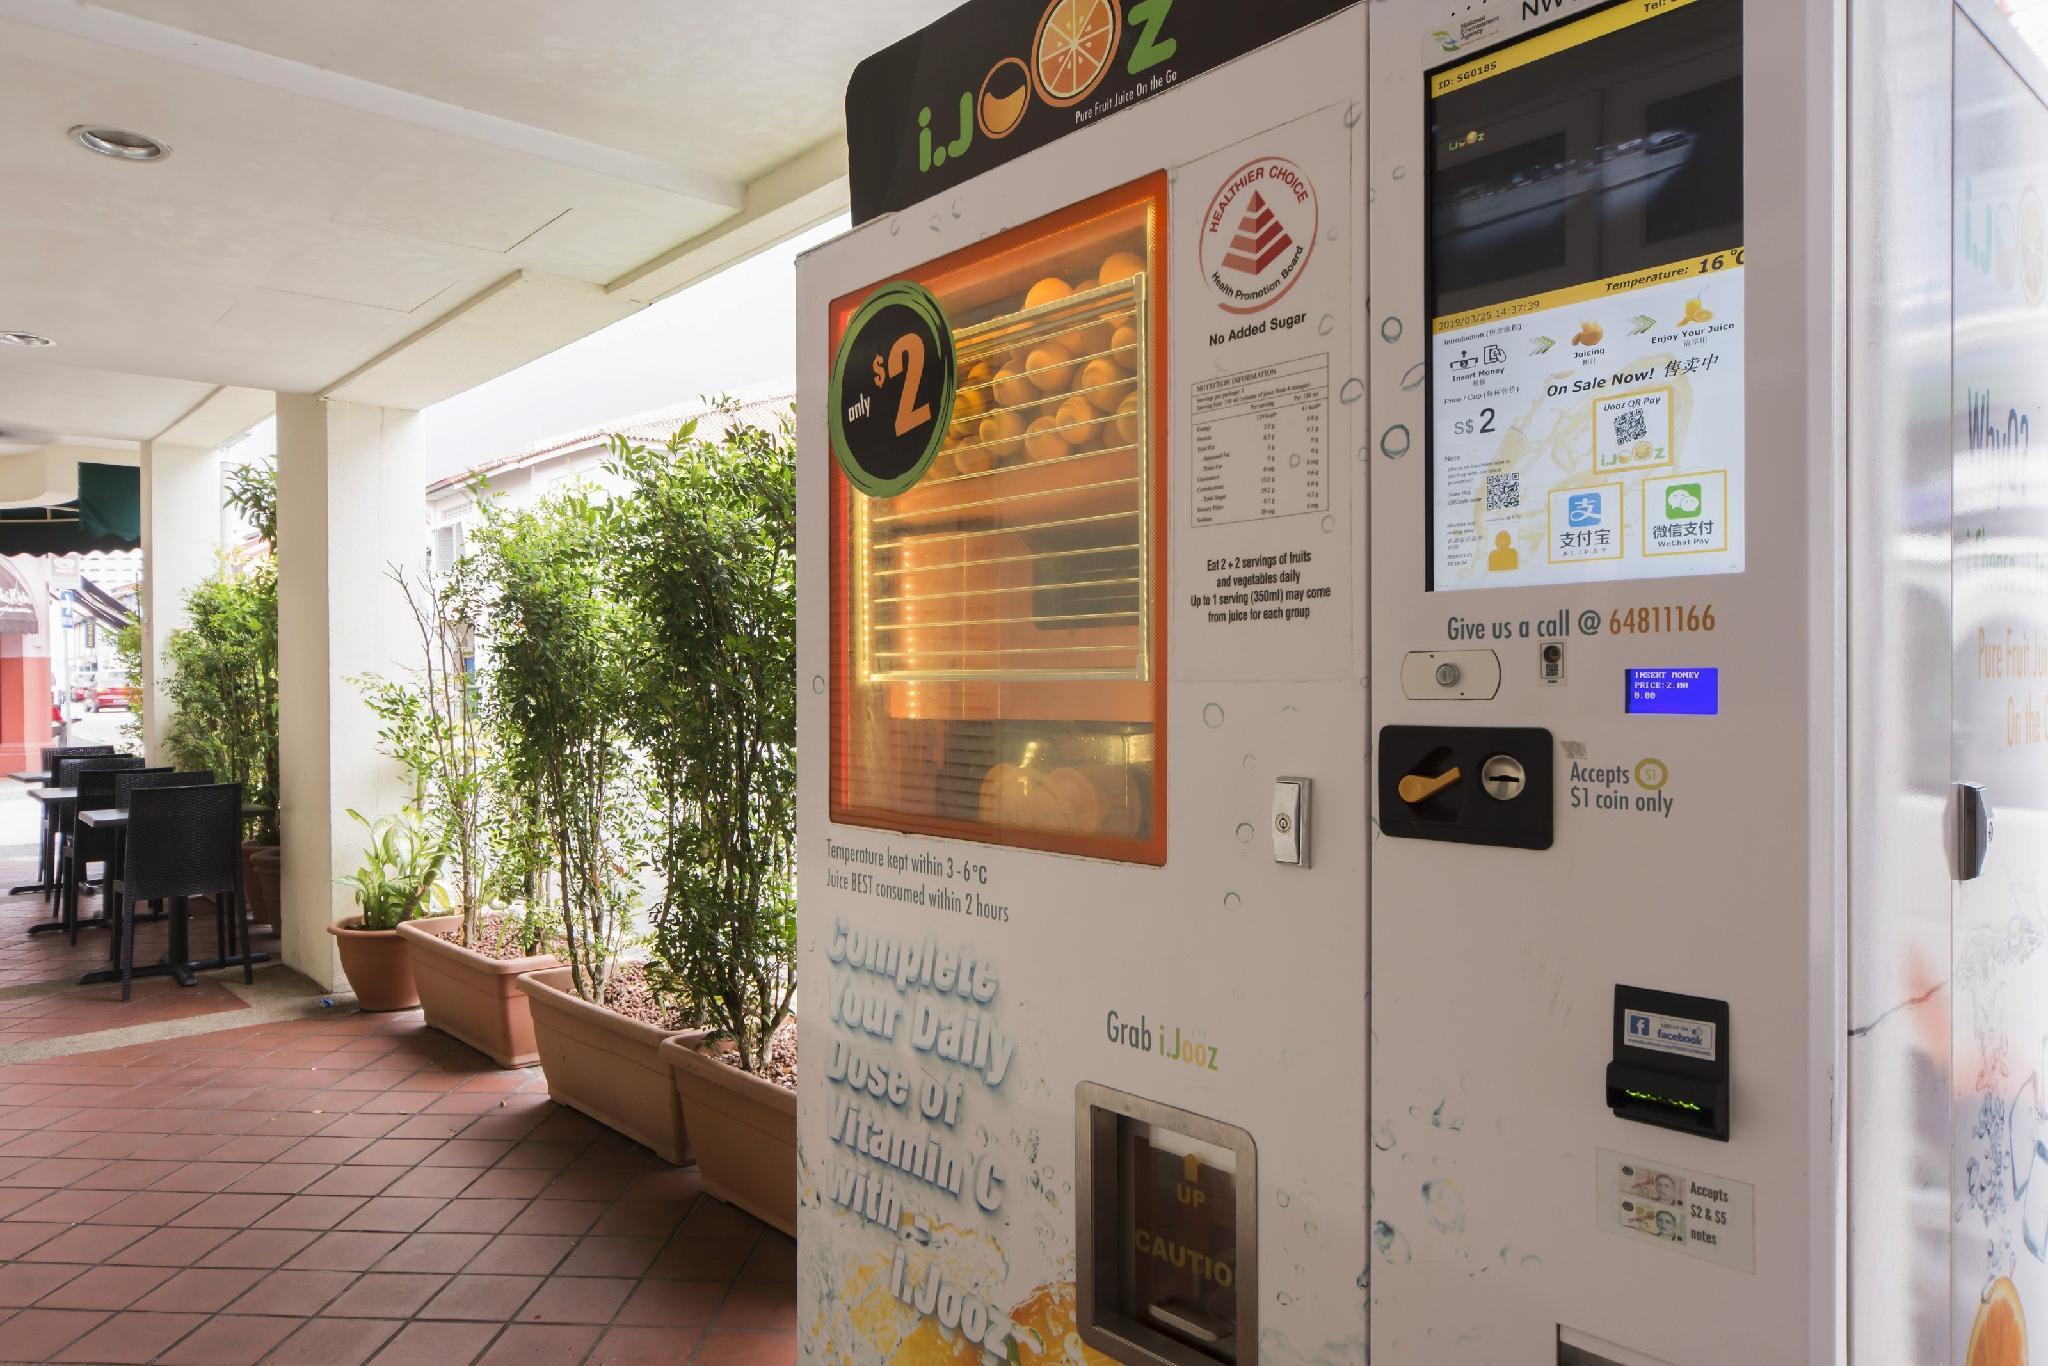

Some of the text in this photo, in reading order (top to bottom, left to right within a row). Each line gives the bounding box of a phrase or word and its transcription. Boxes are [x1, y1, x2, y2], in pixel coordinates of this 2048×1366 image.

[1460, 15, 1486, 29] National
[1522, 0, 1577, 20] NW
[1460, 16, 1499, 35] Environment
[1460, 28, 1484, 41] Agency
[1438, 61, 1497, 89] ID: SG0185
[1075, 69, 1177, 124] Pure Fruit Juice On the Go
[1209, 165, 1309, 233] HEALTHIER CHOICE
[1211, 245, 1304, 301] Health Promotion Board
[1606, 266, 1689, 292] Temperature:
[1699, 254, 1724, 274] 16
[1496, 300, 1540, 317] 14:37:39
[1209, 312, 1307, 346] No Added Sugar
[1444, 332, 1485, 345] Introduction
[1651, 322, 1735, 344] Enjoy Your Juice
[1574, 348, 1605, 358] Juicing
[1196, 368, 1277, 392] NUTRITION INFORMATION
[1452, 368, 1505, 382] Insert Money
[1547, 353, 1719, 397] On Sale Now! 售卖中
[848, 393, 871, 423] only
[1628, 400, 1641, 409] QR
[1644, 396, 1661, 405] Pay
[1454, 407, 1495, 434] S$ 2
[1560, 528, 1611, 549] 支付宝
[1652, 520, 1714, 540] 微信支付
[1658, 537, 1710, 548] WeChat Pay
[1207, 559, 1219, 571] Eat
[1221, 558, 1226, 570] 2
[1235, 557, 1240, 569] 2
[1242, 555, 1277, 569] servings
[1279, 552, 1287, 565] of
[1289, 550, 1311, 563] fruits
[1217, 569, 1300, 588] and vegetables daily
[1190, 586, 1331, 608] Up to 1 serving (350ml) may come
[1208, 607, 1310, 624] from juice for each group
[1447, 604, 1716, 641] Give us a call @ 64811166
[1978, 624, 2001, 679] Pure
[1635, 671, 1700, 679] INSERT MONEY
[1570, 761, 1630, 788] Accepts
[1570, 785, 1673, 818] $1 coin only
[826, 838, 884, 866] Temperature
[887, 846, 908, 875] kept
[911, 852, 943, 877] within
[826, 868, 1009, 922] Juice BEST consumed within 2 hours
[826, 915, 998, 1003] Complete
[829, 975, 1014, 1087] Your Daily
[1106, 1009, 1152, 1052] Grab
[1657, 1029, 1703, 1046] facebook
[826, 1039, 963, 1126] Dose of
[829, 1092, 1004, 1212] Vitamin C
[827, 1163, 902, 1232] with
[1176, 1182, 1206, 1208] UP
[1690, 1181, 1728, 1203] Accepts
[1691, 1203, 1727, 1225] $2 & $5
[1691, 1229, 1717, 1245] notes
[1136, 1229, 1234, 1288] CAUTIO
